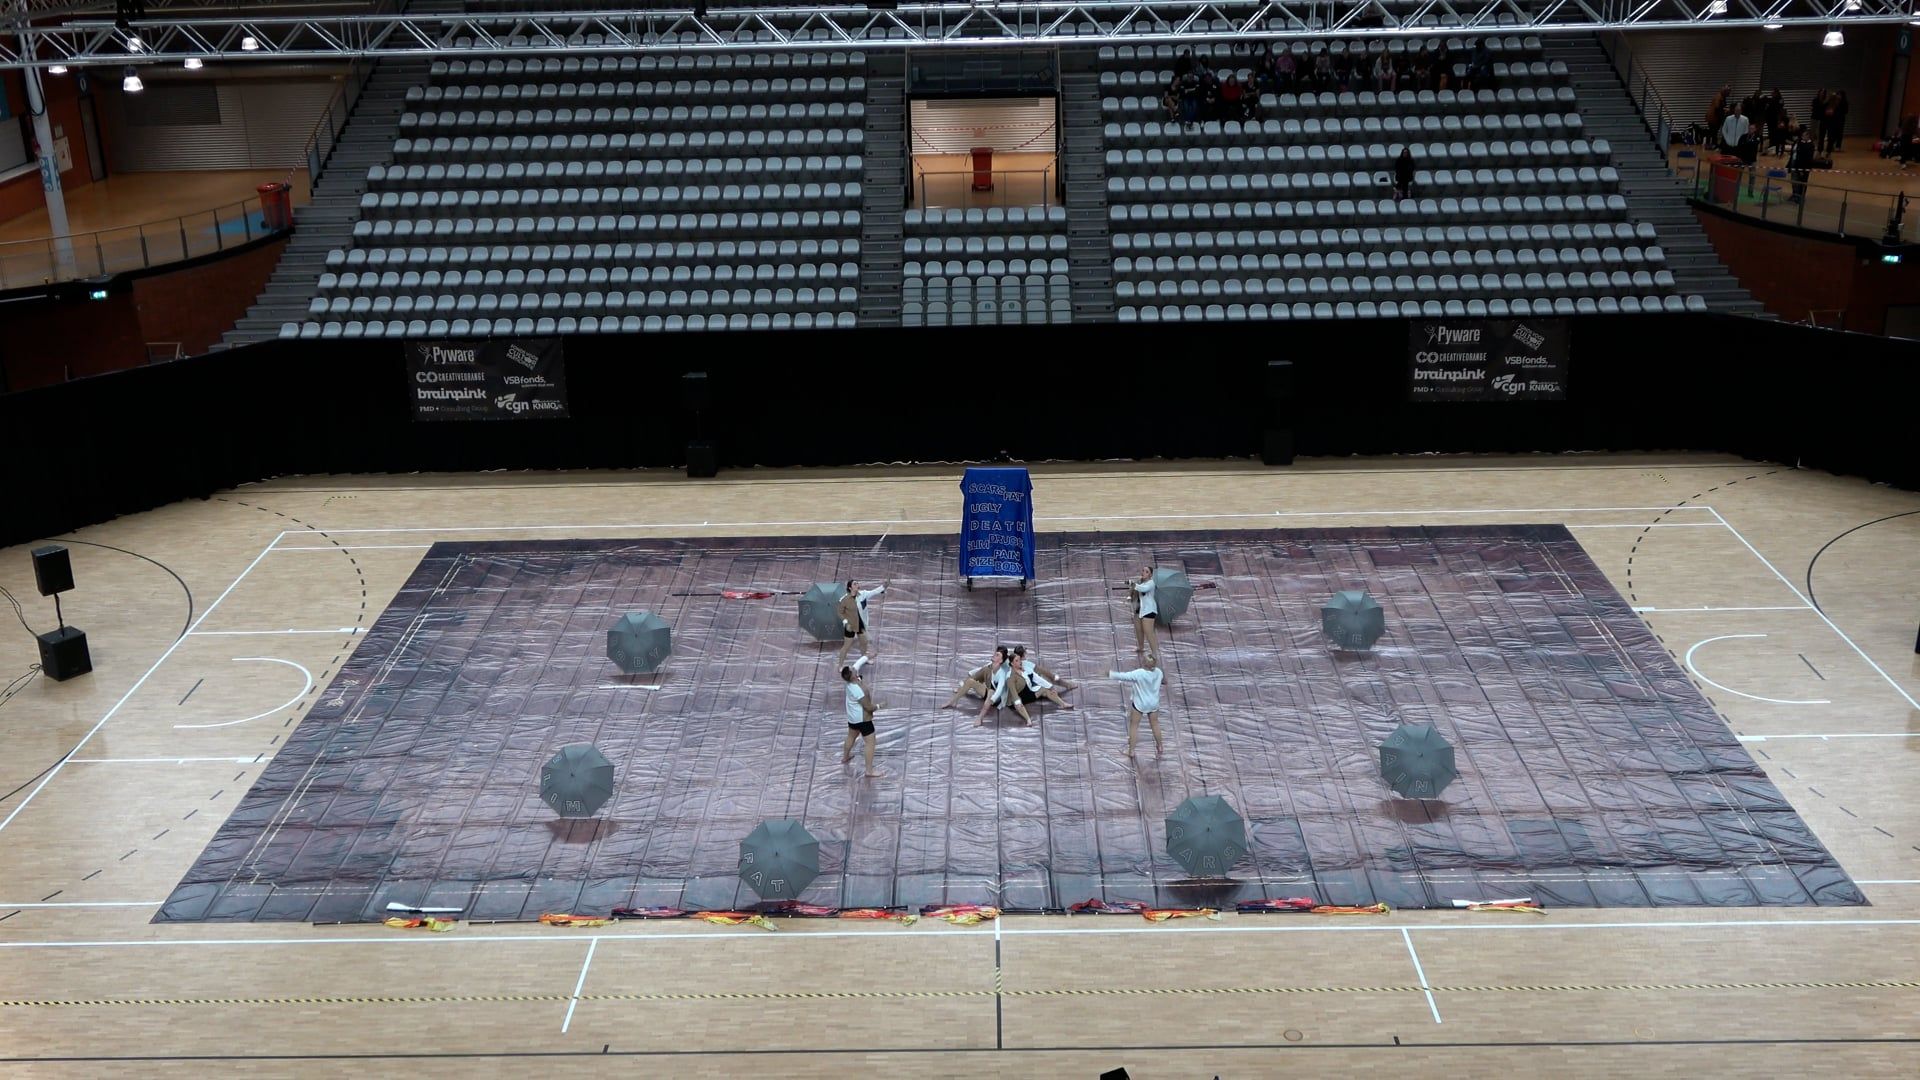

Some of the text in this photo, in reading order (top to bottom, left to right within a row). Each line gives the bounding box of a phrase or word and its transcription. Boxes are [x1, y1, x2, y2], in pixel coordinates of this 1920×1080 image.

[1437, 326, 1481, 345] Pyware
[432, 346, 475, 365] Pyware
[1414, 367, 1486, 382] brainpink
[417, 387, 487, 401] brainpink
[1502, 382, 1526, 395] cgn
[505, 402, 530, 413] cgn
[968, 482, 1006, 495] SCARS
[1003, 491, 1025, 502] FAT
[970, 502, 1002, 513] UGLY
[970, 520, 1026, 532] DEATH
[967, 540, 990, 551] SLIM
[989, 533, 1023, 548] DRUGS
[994, 549, 1021, 561] PAIN
[968, 556, 995, 567] SIZE
[995, 561, 1023, 572] BODY
[743, 852, 784, 892] FAT
